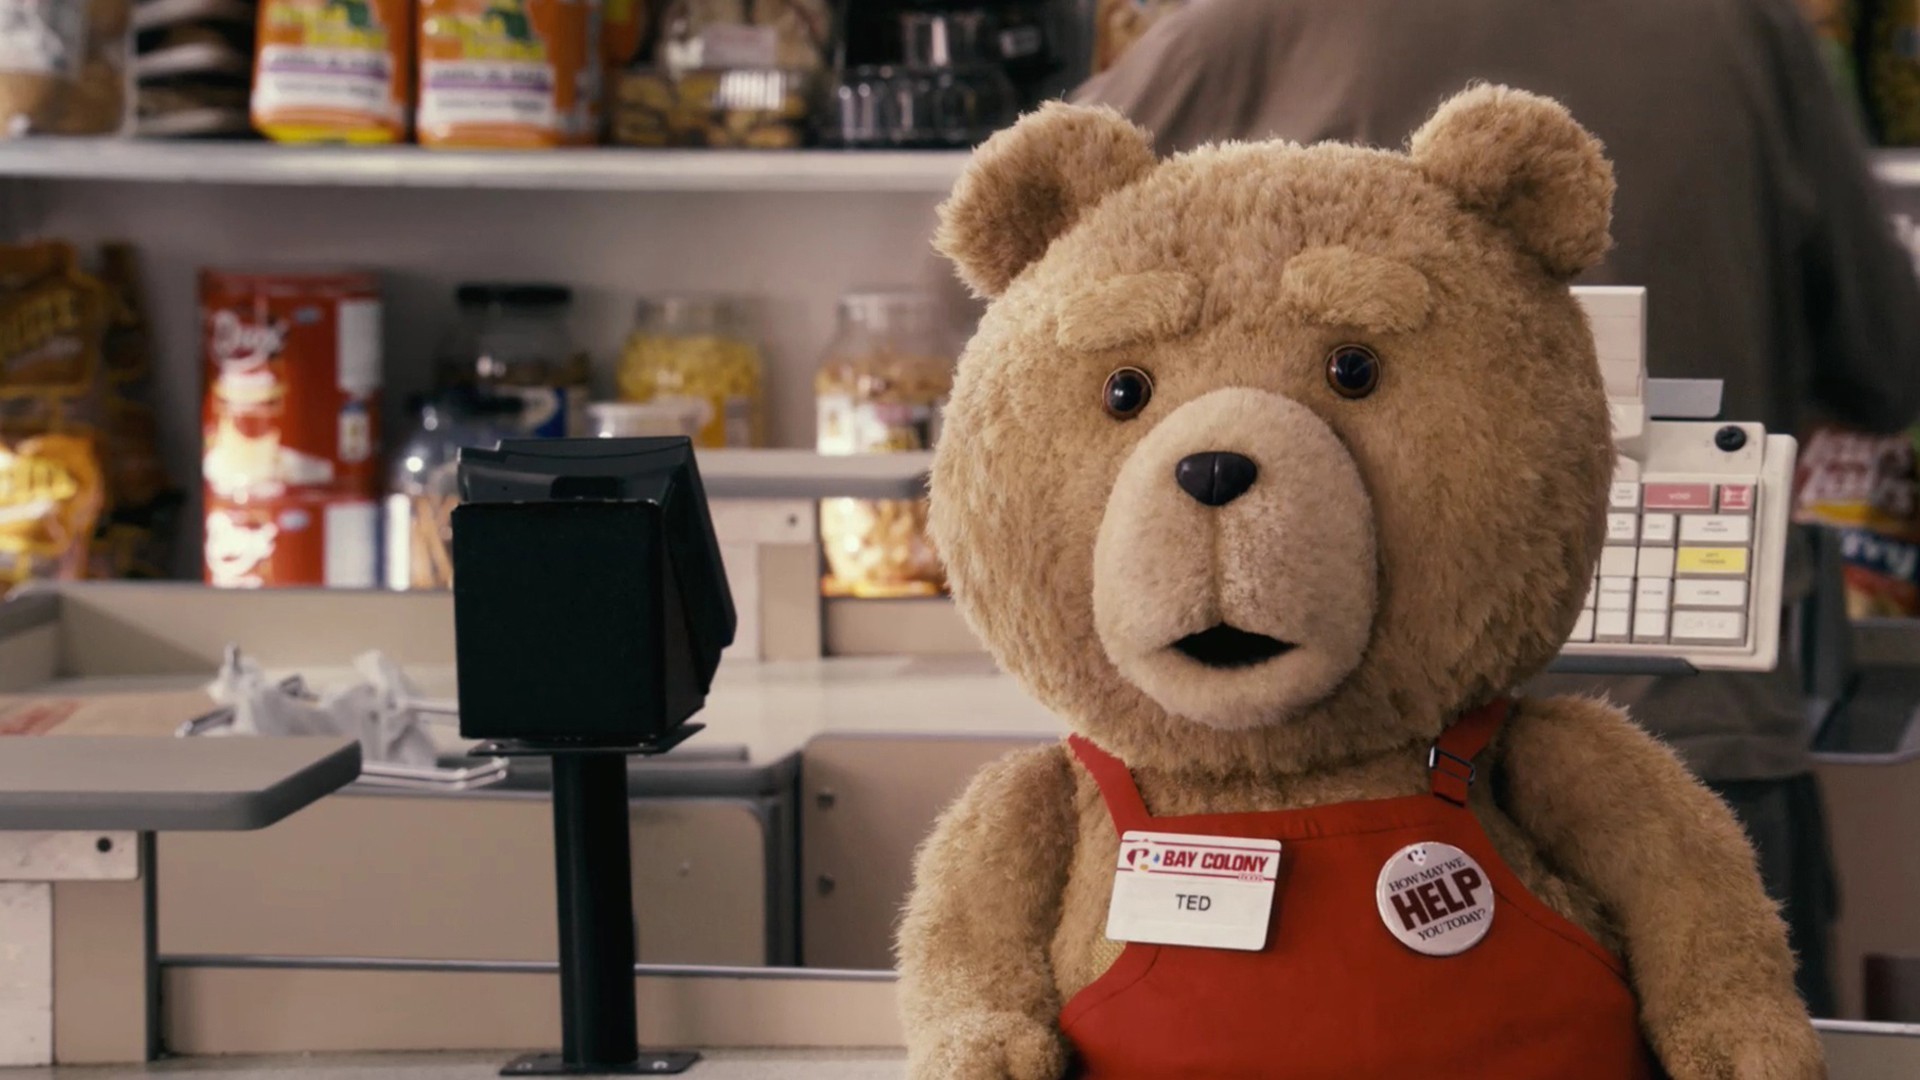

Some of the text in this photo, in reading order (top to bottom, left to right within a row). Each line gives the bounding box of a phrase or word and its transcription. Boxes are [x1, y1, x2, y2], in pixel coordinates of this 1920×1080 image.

[1162, 850, 1269, 872] BAY COLONY
[1389, 857, 1466, 892] HOW MAY WE
[1175, 893, 1212, 911] TED
[1390, 867, 1482, 931] HELP
[1418, 908, 1486, 941] YOU TODAY?
